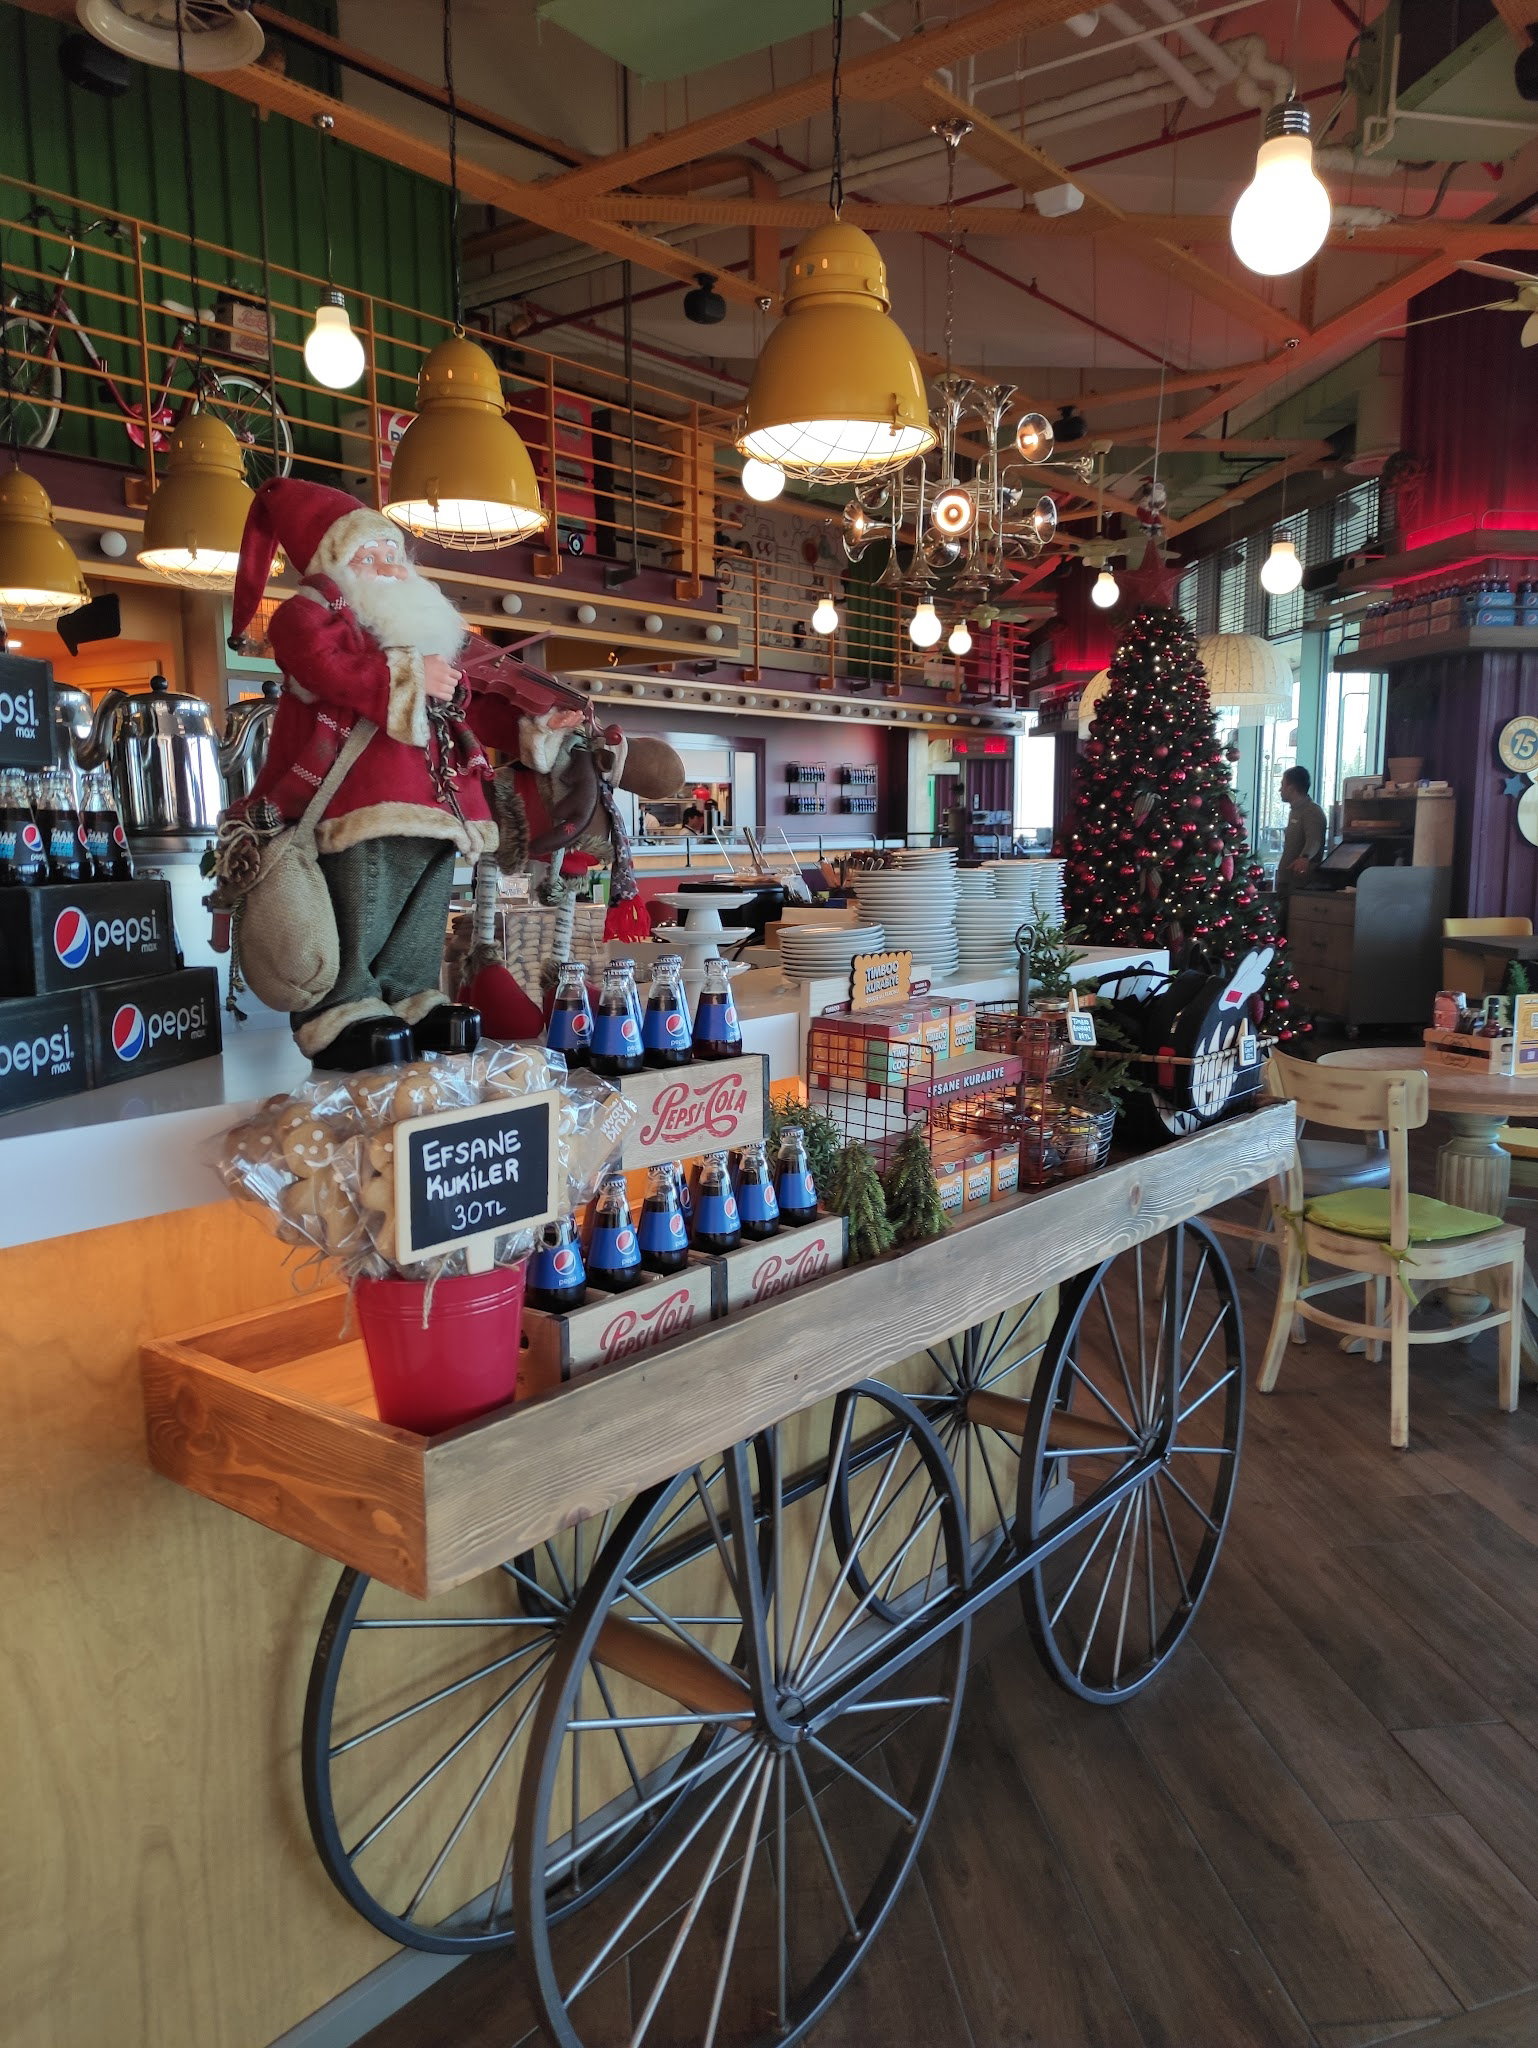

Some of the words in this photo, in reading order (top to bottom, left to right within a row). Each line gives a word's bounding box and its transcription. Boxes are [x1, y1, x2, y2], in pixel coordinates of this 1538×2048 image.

[15, 726, 36, 739] max
[1513, 733, 1536, 757] 15
[94, 909, 158, 957] pepsi
[141, 942, 158, 953] max
[865, 960, 900, 982] TIMBOO
[148, 997, 206, 1048] pepsi
[190, 1028, 206, 1040] max
[51, 1060, 71, 1076] max
[422, 1129, 522, 1172] EFSANE
